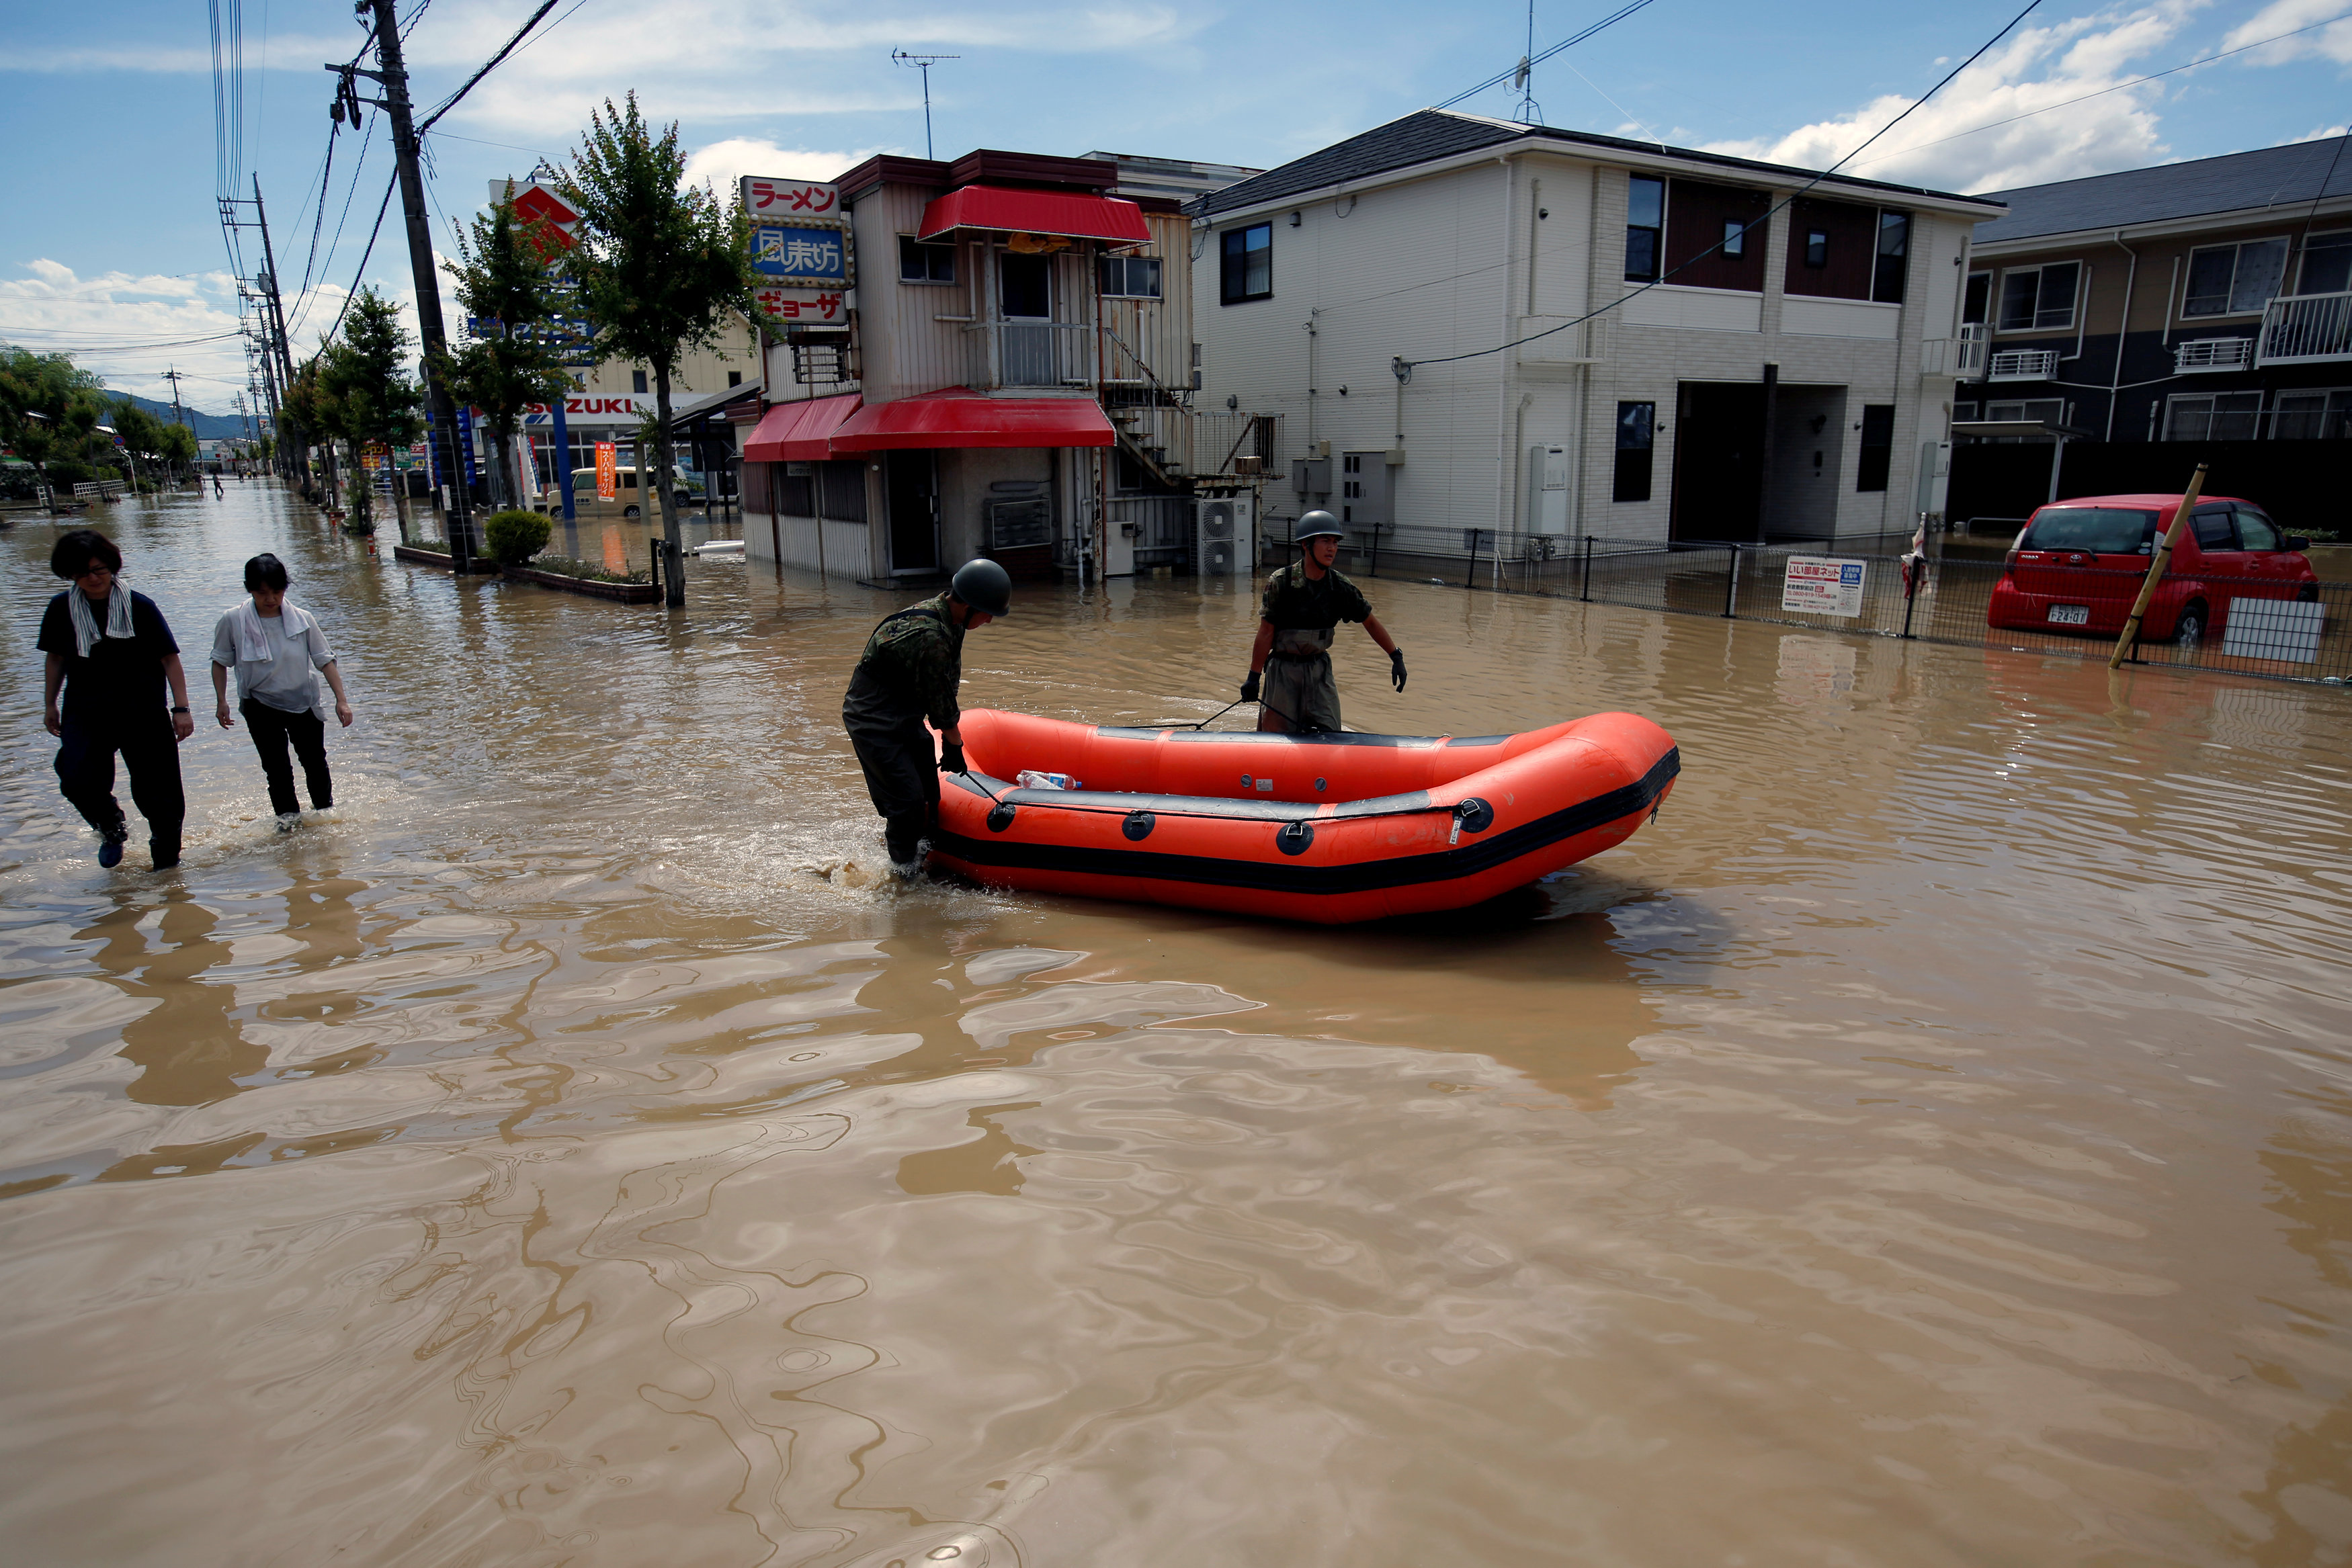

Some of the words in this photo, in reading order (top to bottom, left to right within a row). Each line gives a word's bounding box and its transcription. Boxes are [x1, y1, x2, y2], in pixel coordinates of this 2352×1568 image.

[752, 182, 835, 212] ラーメン
[755, 229, 839, 273] 風来坊
[757, 290, 842, 320] ギョーザ
[1788, 565, 1840, 577] いい部屋ネット
